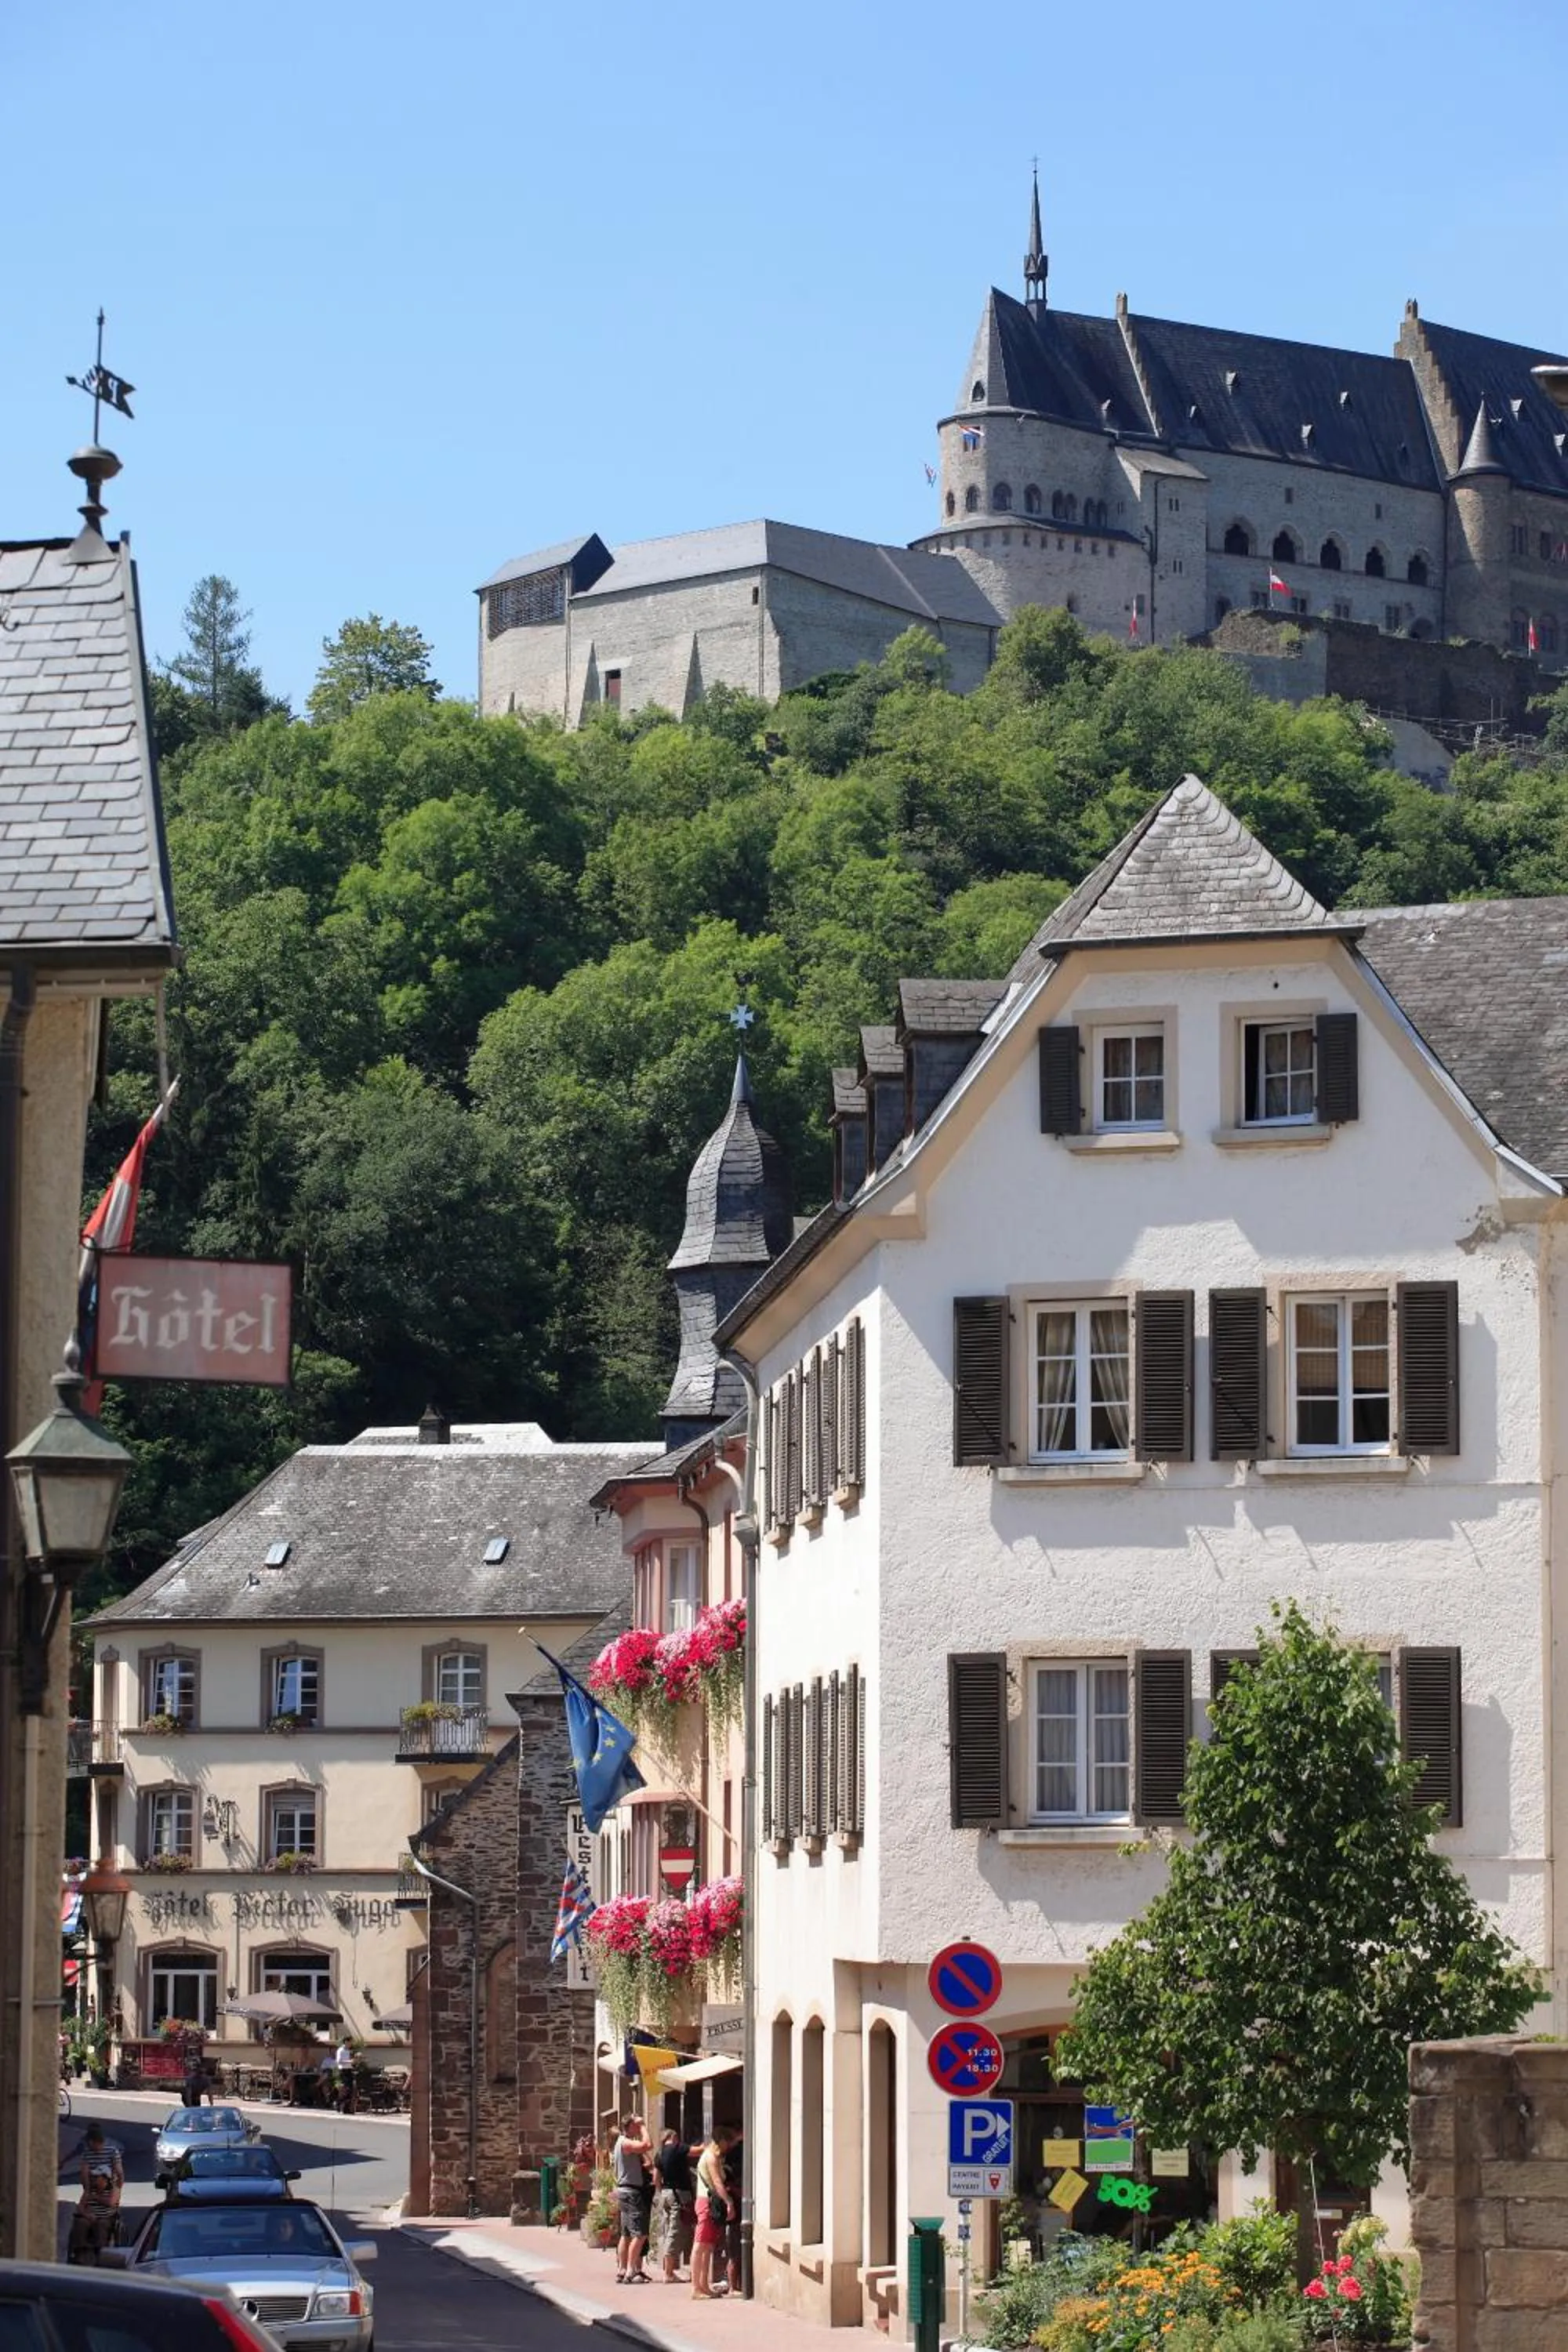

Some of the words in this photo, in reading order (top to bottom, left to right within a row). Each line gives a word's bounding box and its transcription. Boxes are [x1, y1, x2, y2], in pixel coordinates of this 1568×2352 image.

[964, 2108, 996, 2157] P
[982, 2133, 1010, 2164] GRATUIT
[1098, 2173, 1160, 2212] 50%
